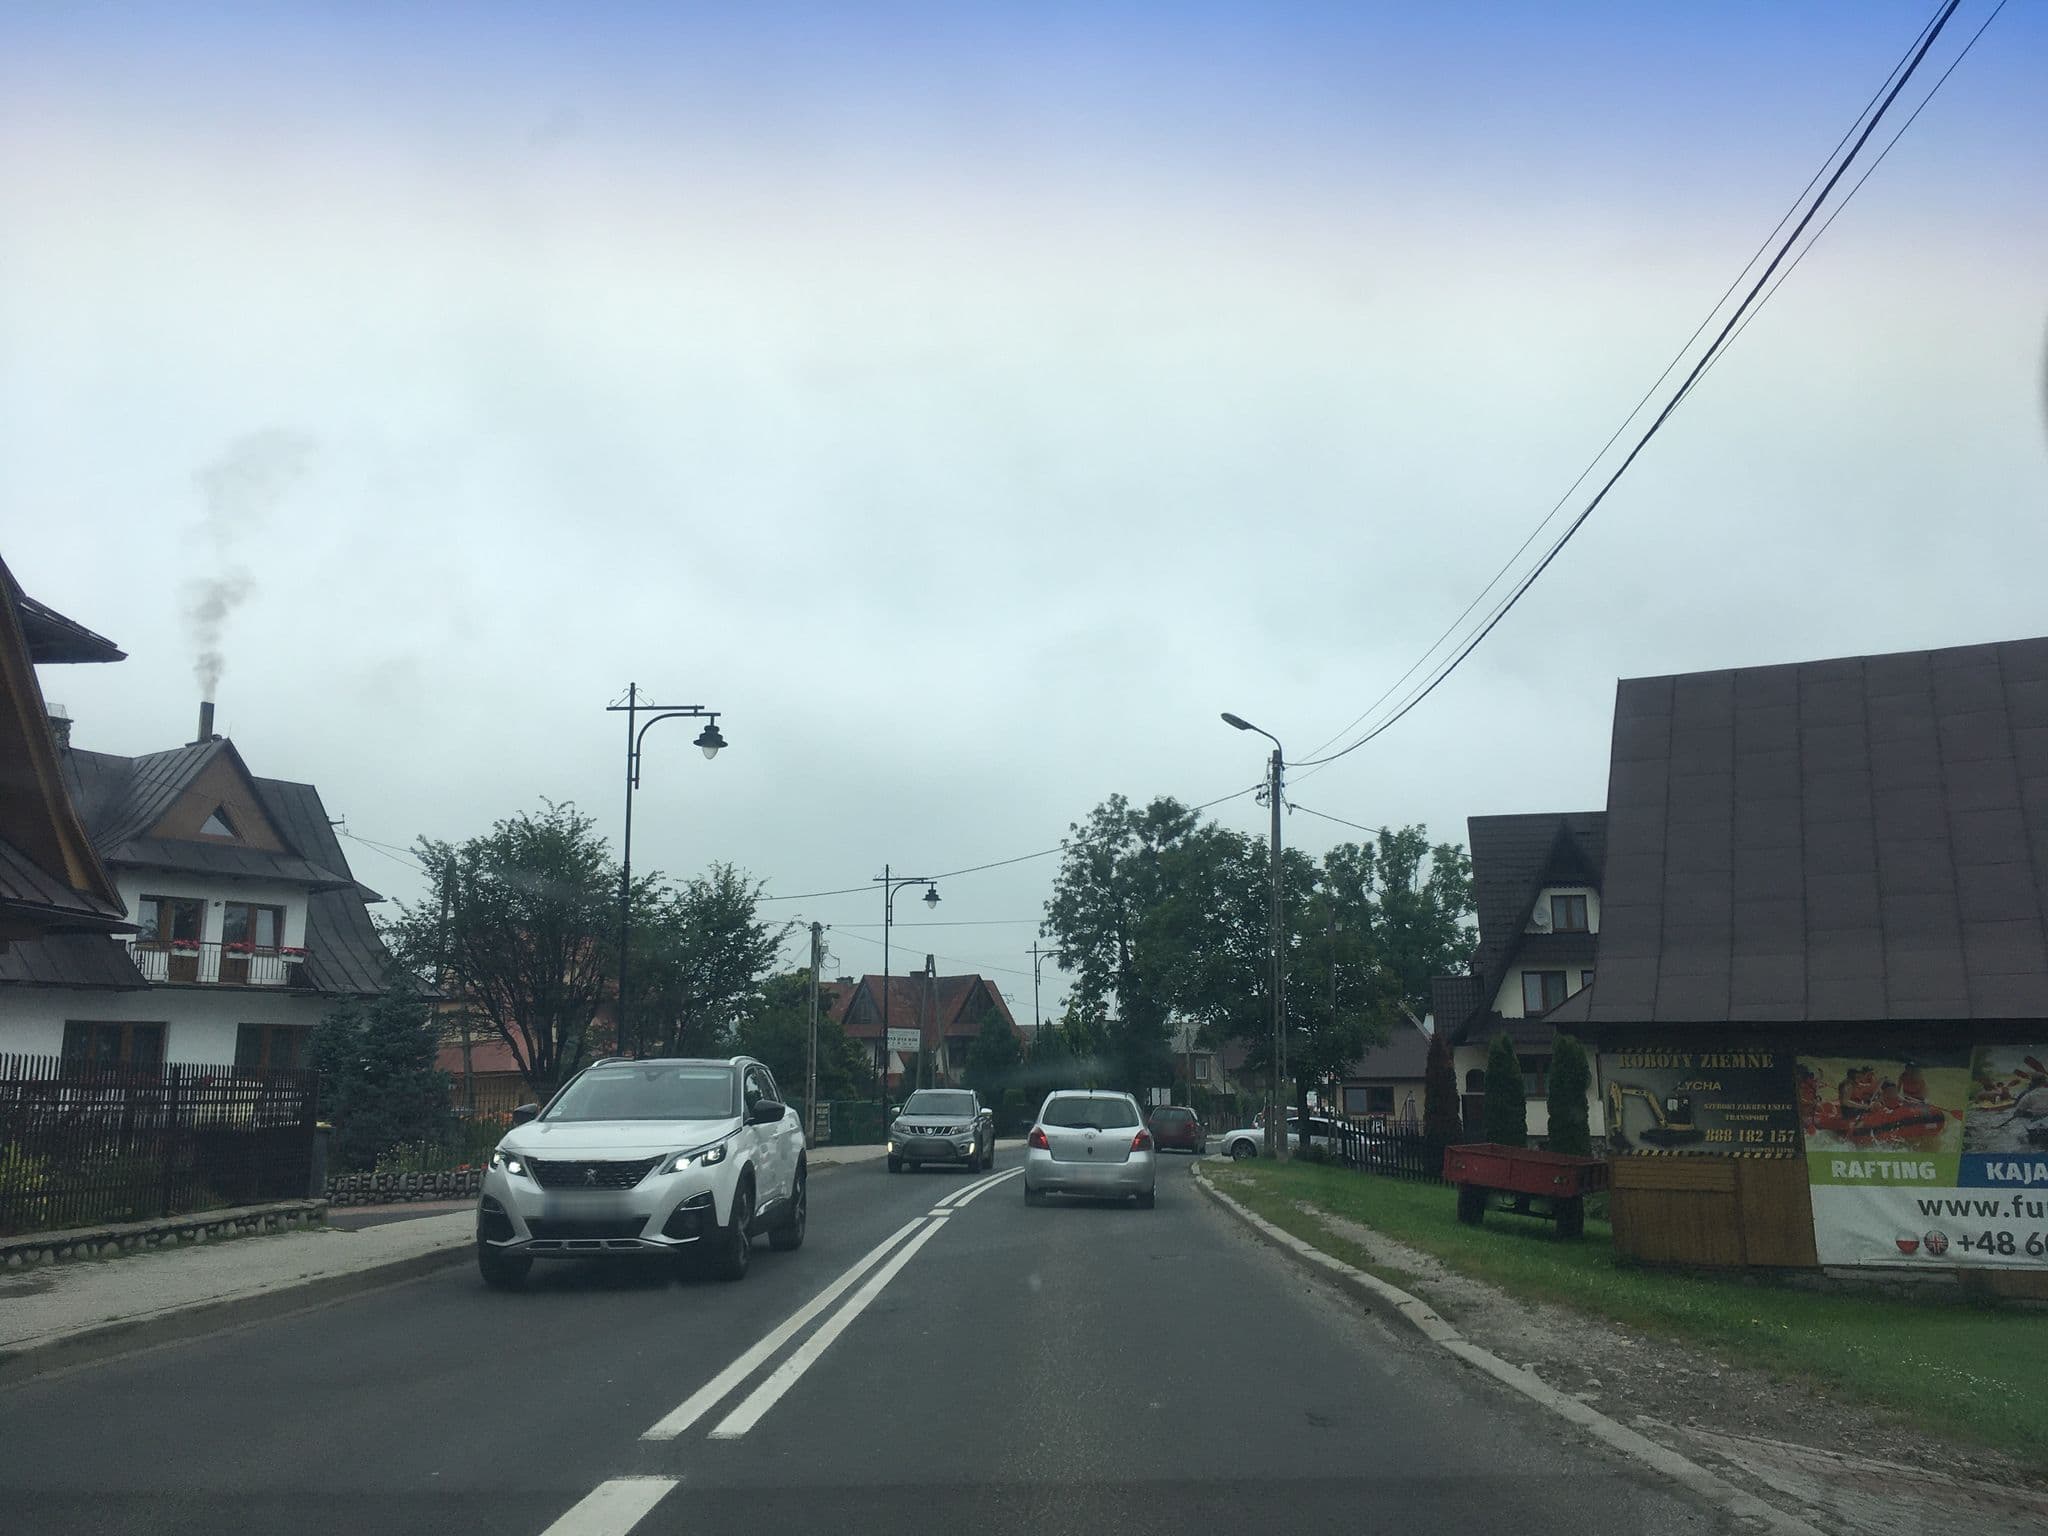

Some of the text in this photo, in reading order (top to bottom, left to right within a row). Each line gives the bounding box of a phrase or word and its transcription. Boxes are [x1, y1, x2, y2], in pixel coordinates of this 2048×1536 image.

[1616, 1054, 1775, 1069] ROBOTY ZIEMNE
[1704, 1128, 1796, 1143] 888 182 157
[1831, 1159, 1937, 1180] RAFTING
[1917, 1194, 2048, 1218] www.fu
[1957, 1231, 2048, 1257] +48 6
